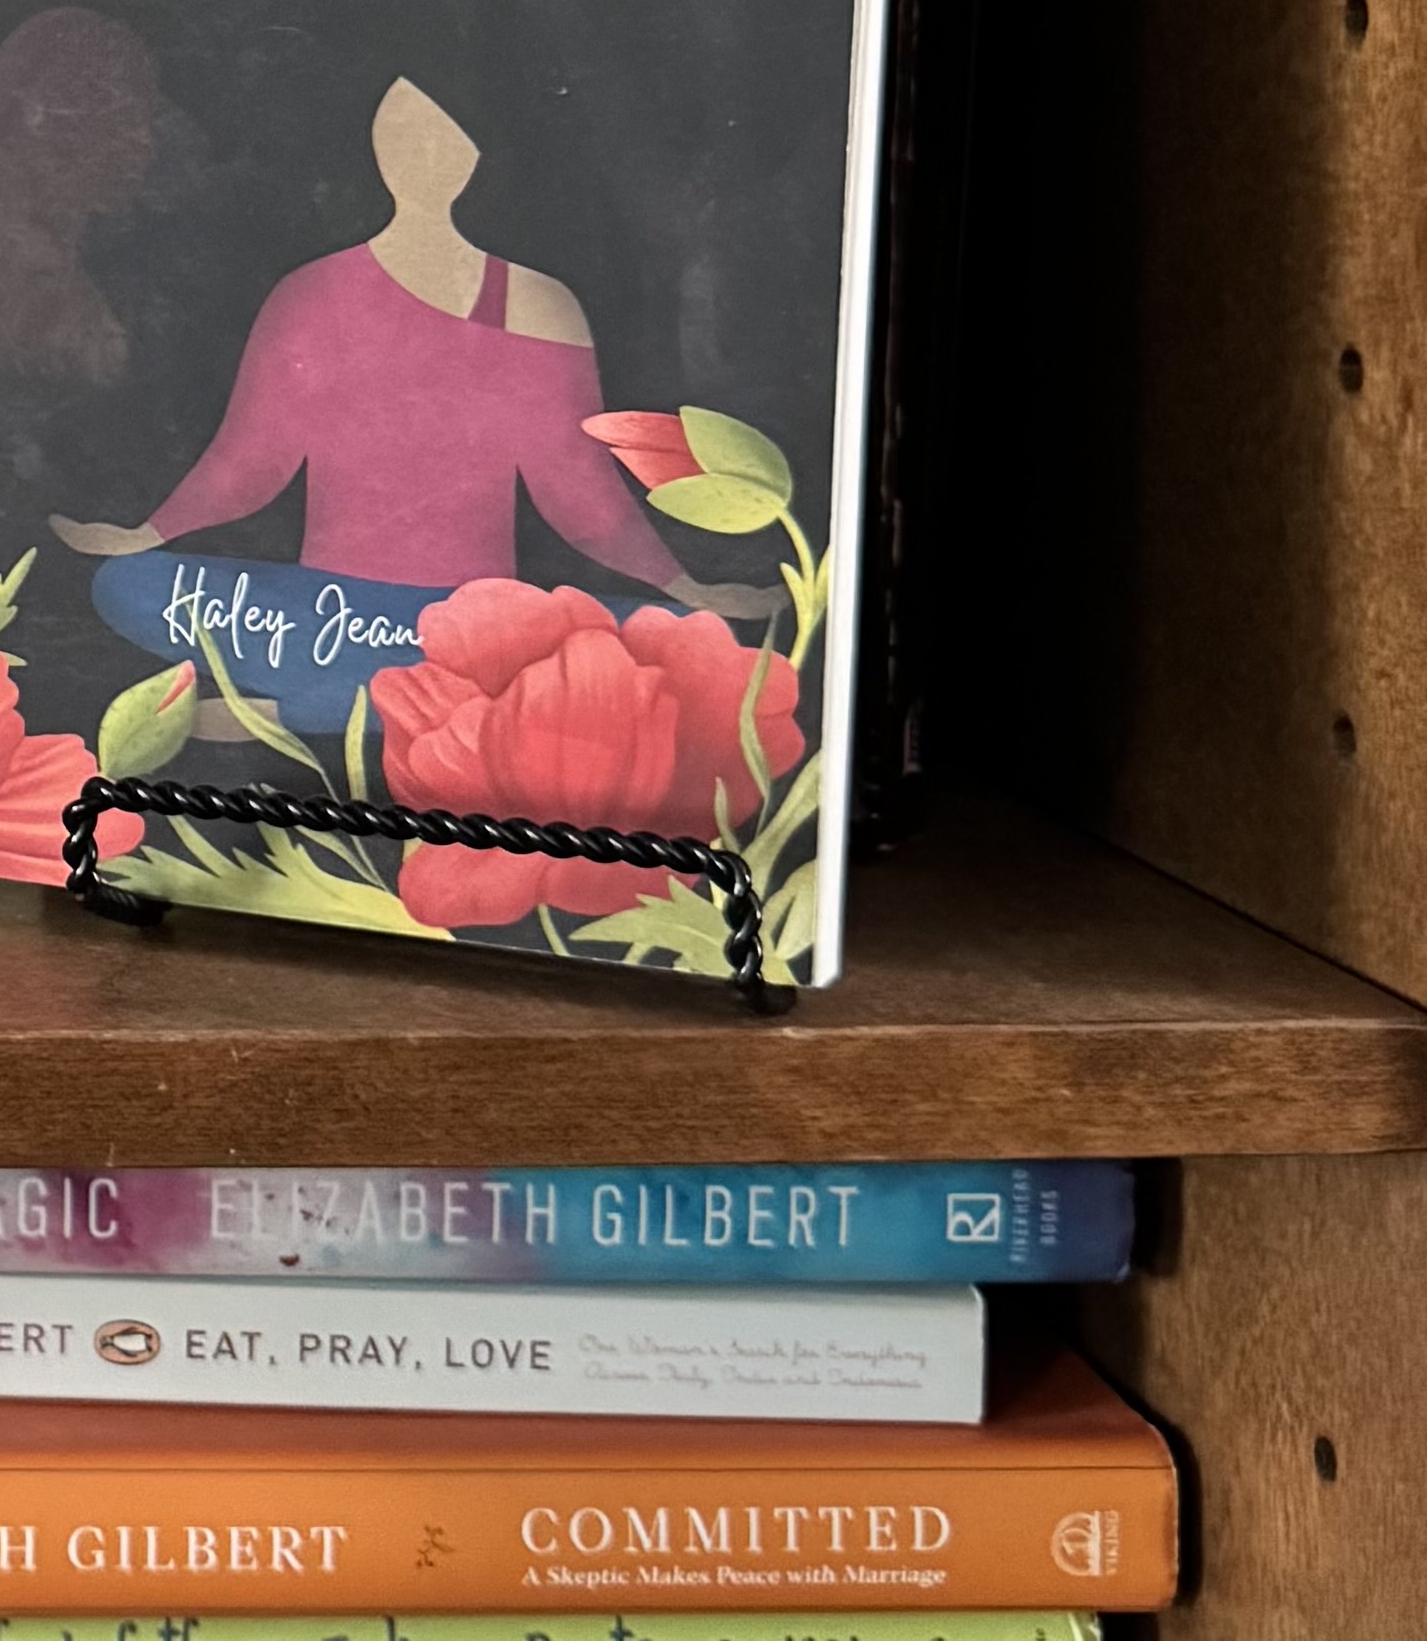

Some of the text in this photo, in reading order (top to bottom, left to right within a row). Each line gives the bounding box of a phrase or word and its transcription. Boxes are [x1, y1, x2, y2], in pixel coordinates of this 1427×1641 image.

[162, 563, 424, 668] Haley Jean
[185, 1329, 276, 1364] EAT,
[298, 1334, 422, 1370] PRAY,
[445, 1338, 552, 1370] LOVE
[66, 1524, 348, 1572] GILBERT
[520, 1505, 951, 1556] COMMITTED
[522, 1565, 947, 1590] A Skeptic Makes Peace with Marriage
